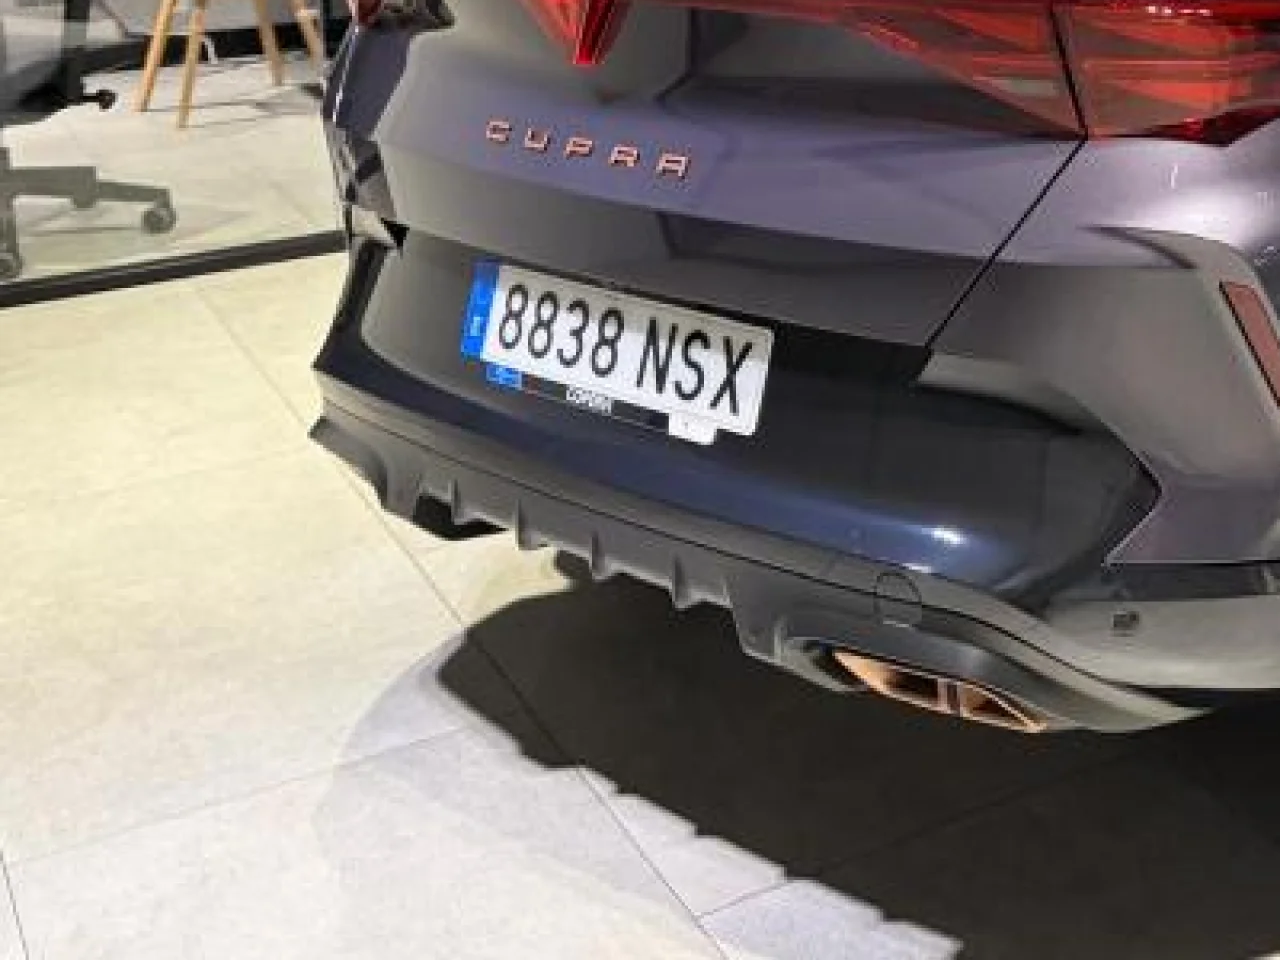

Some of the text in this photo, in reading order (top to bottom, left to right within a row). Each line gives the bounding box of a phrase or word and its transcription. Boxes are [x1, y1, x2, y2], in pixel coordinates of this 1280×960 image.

[486, 119, 691, 179] CUPRA
[499, 283, 754, 417] 8838 NSX
